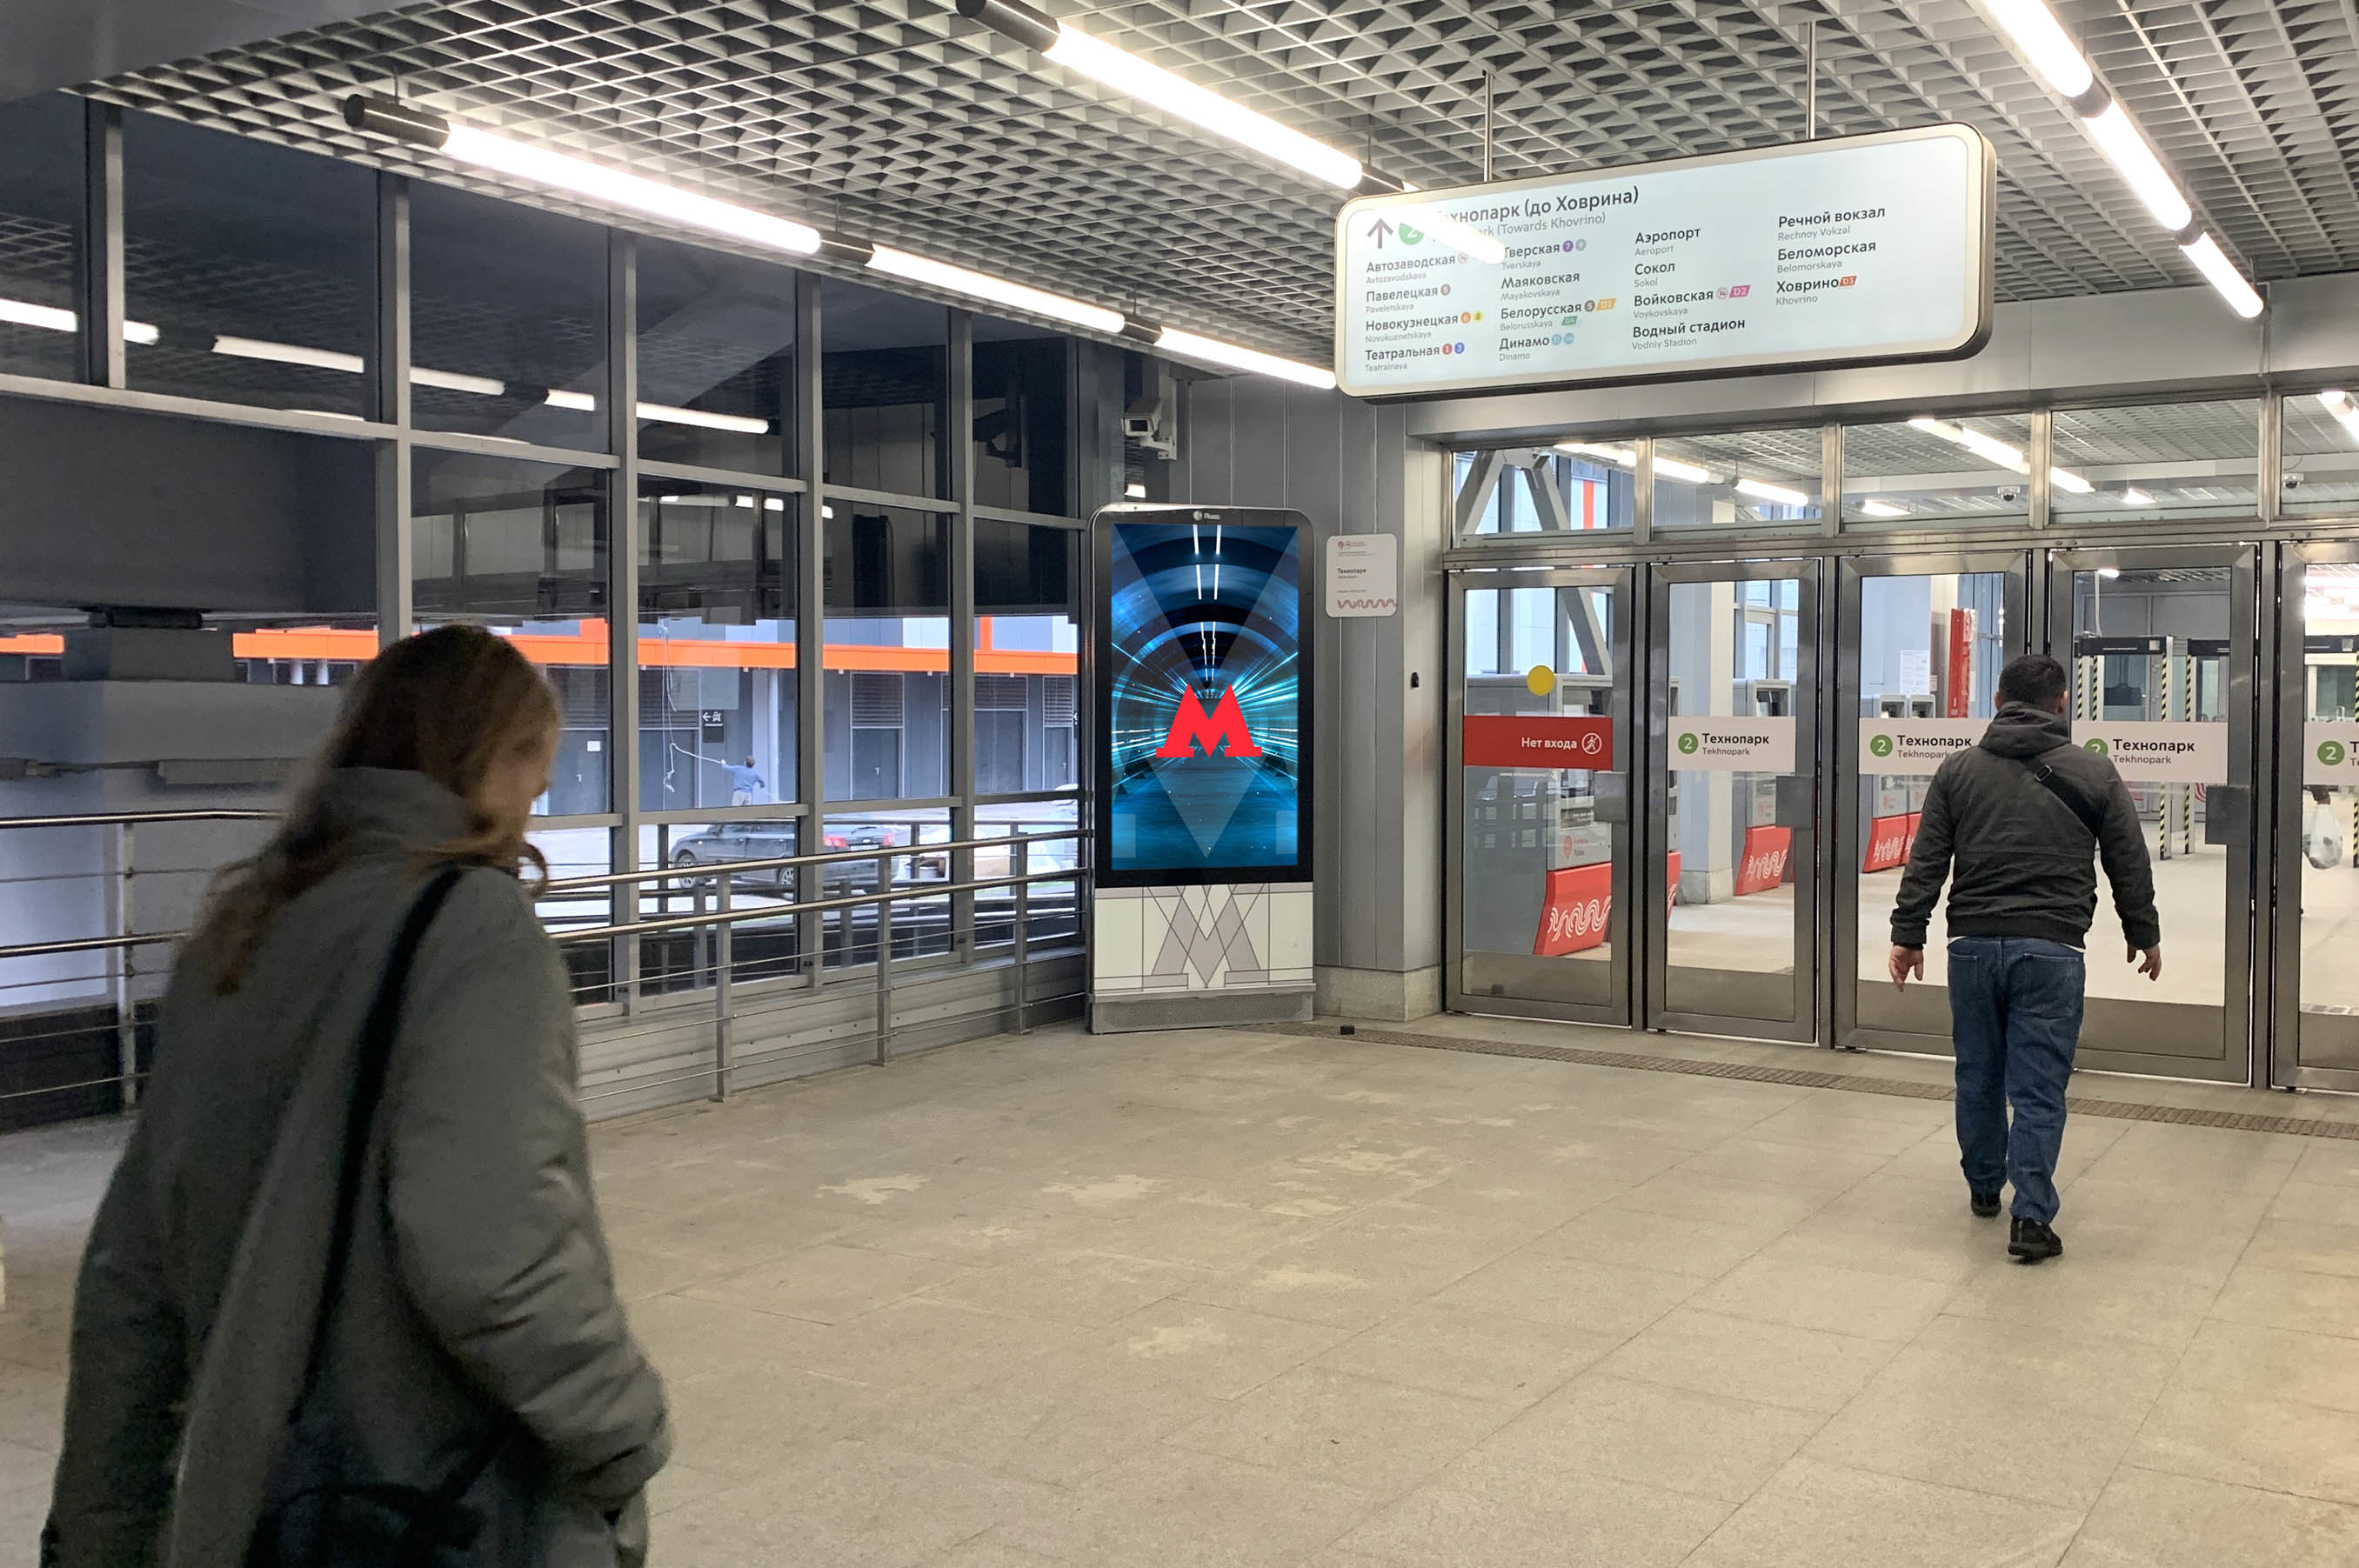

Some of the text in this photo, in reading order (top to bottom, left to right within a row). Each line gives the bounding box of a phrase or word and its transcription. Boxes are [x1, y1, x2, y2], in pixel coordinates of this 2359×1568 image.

[1441, 203, 1520, 224] хнопарк
[1525, 198, 1551, 217] (до
[1556, 186, 1639, 211] Ховрина)
[1497, 222, 1547, 236] (Towards
[1551, 212, 1606, 229] Khovrino)
[1779, 208, 1886, 228] Речной вокзал
[1635, 228, 1701, 244] Аэропорт
[1778, 225, 1850, 241] Rechnoy Vokzal
[1504, 244, 1560, 258] Тверская
[1635, 245, 1674, 256] Aeroport
[1778, 242, 1876, 261] Беломорская
[1367, 255, 1456, 273] Автозаводская
[1503, 260, 1541, 270] Tverskaya
[1635, 263, 1675, 275] Сокол
[1777, 261, 1842, 274] Belomorskaya
[1366, 271, 1427, 284] Avtozavodskaya
[1501, 273, 1580, 289] Маяковская
[1634, 277, 1658, 288] Sokol
[1776, 278, 1839, 293] Ховрино
[1367, 287, 1438, 302] Павелецкая
[1500, 288, 1560, 301] Mayakovskaya
[1635, 290, 1714, 306] Войковская
[1775, 294, 1818, 306] Khovrino
[1366, 302, 1414, 314] Paveletskaya
[1500, 304, 1581, 319] Белорусская
[1634, 307, 1687, 319] Voykovskaya
[1366, 315, 1458, 331] Новокузнецкая
[1500, 319, 1553, 331] Belorusskaya
[1634, 319, 1745, 338] Водный стадион
[1365, 330, 1432, 344] Novokuznetskaya
[1499, 337, 1549, 351] Динамо
[1632, 337, 1697, 350] Vodniy Stadion
[1365, 346, 1440, 361] Театральная
[1499, 353, 1531, 362] Dinamo
[1365, 362, 1407, 373] Teatralnaya
[1521, 737, 1578, 751] Нет входа
[1701, 733, 1769, 747] Технопарк
[1896, 735, 1972, 749] Технопарк
[2113, 738, 2195, 754] Технопарк
[1702, 746, 1750, 757] Tekhnopark
[2113, 754, 2171, 765] Tekhnopark
